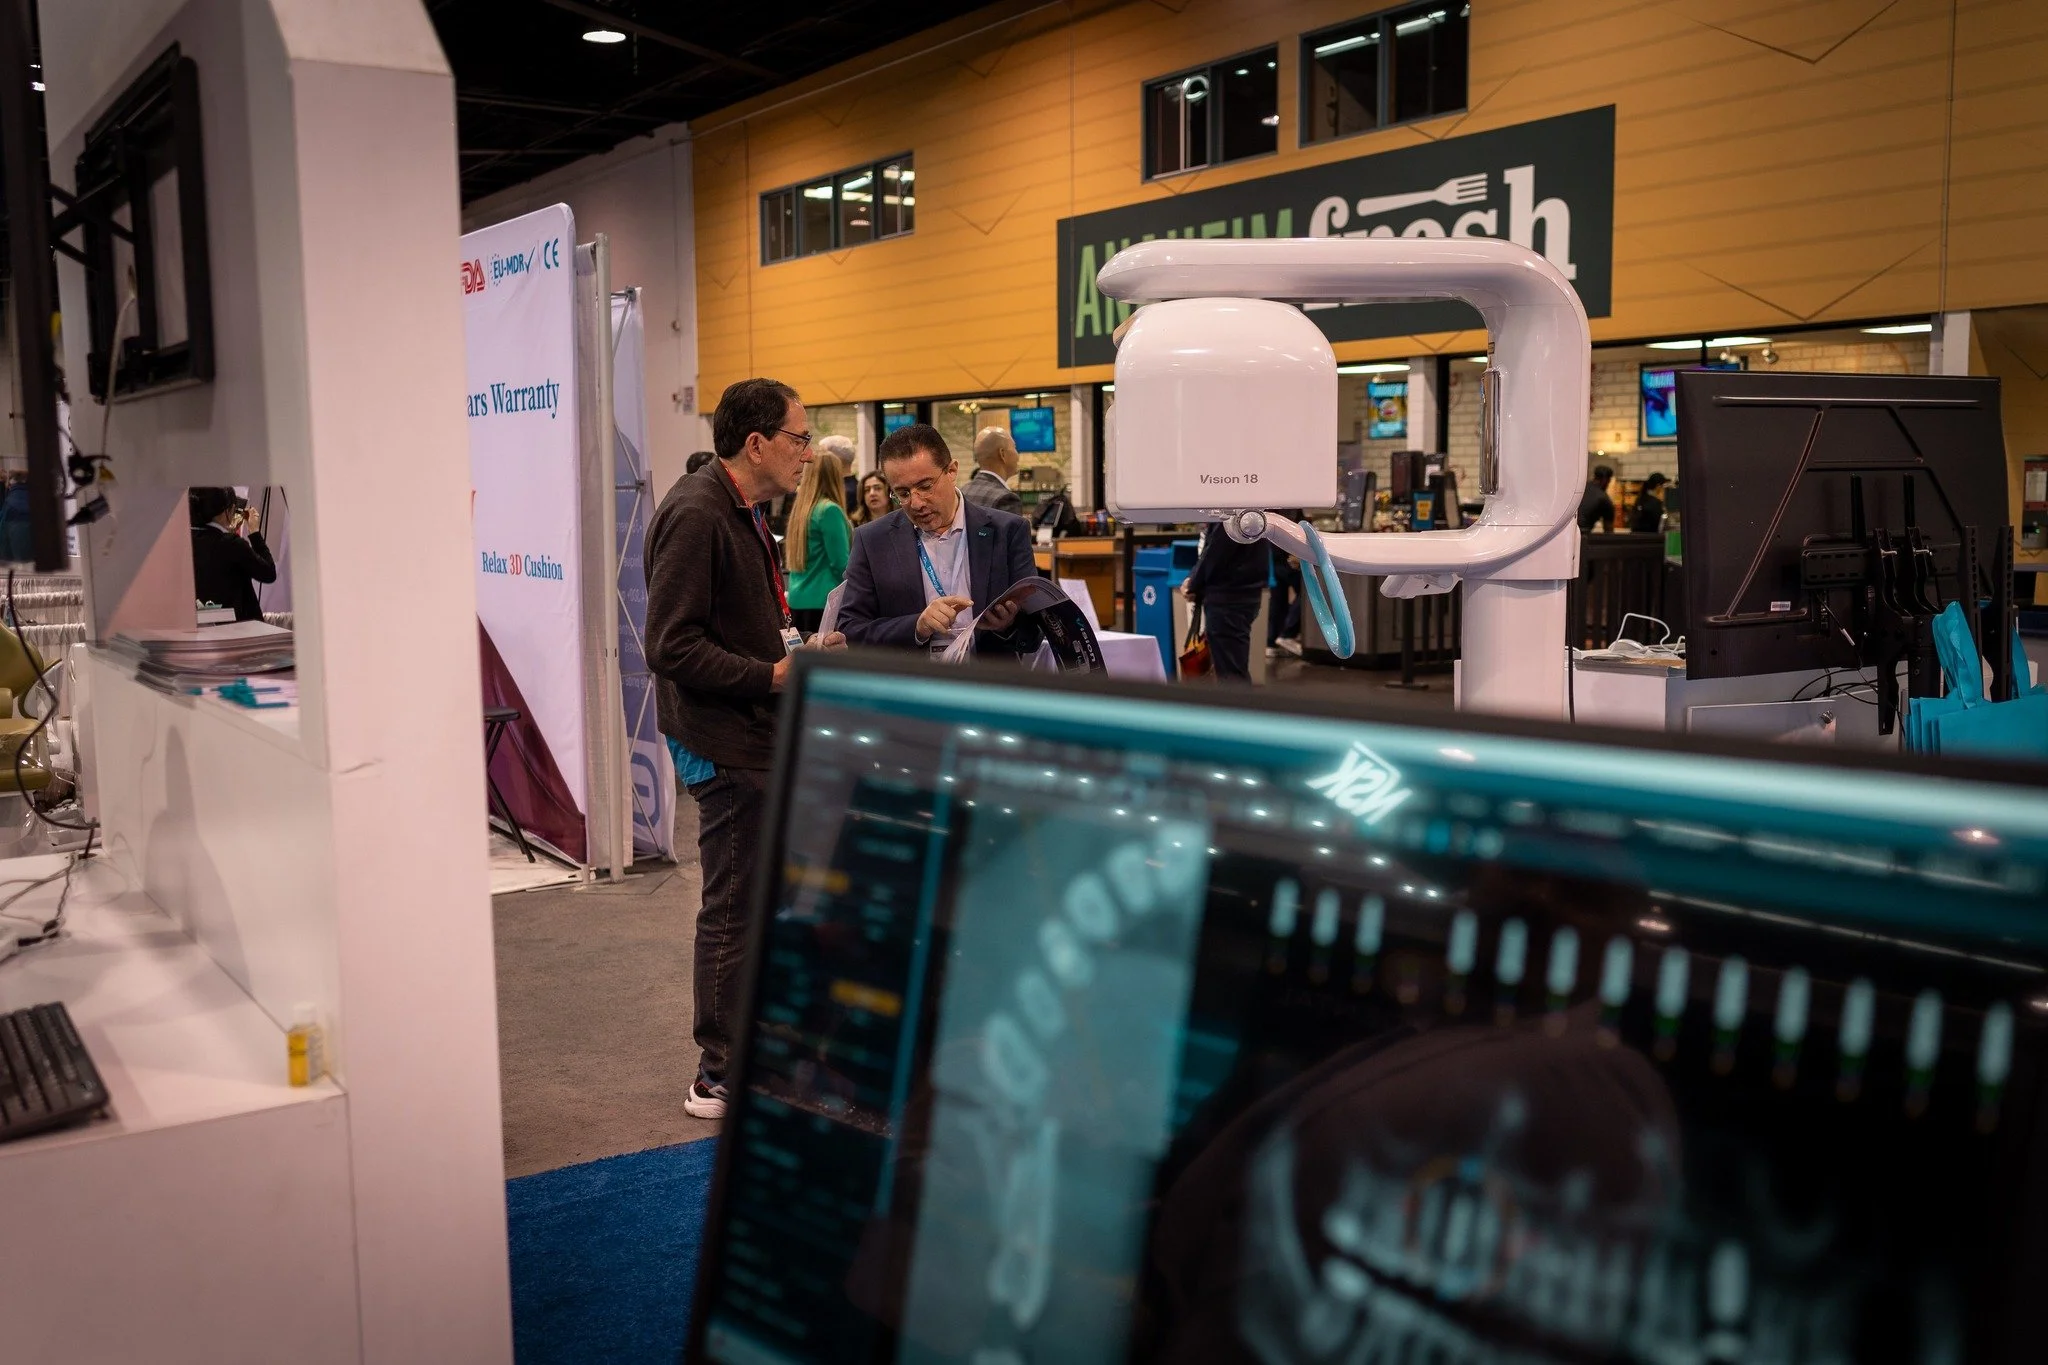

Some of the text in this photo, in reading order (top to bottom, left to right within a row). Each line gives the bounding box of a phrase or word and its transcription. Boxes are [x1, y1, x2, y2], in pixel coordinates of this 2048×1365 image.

[461, 238, 559, 295] DA EU-MDR CE
[467, 378, 560, 419] ars Warranty
[1200, 474, 1259, 484] Vision 18
[482, 551, 563, 580] Relax 3D Cushion
